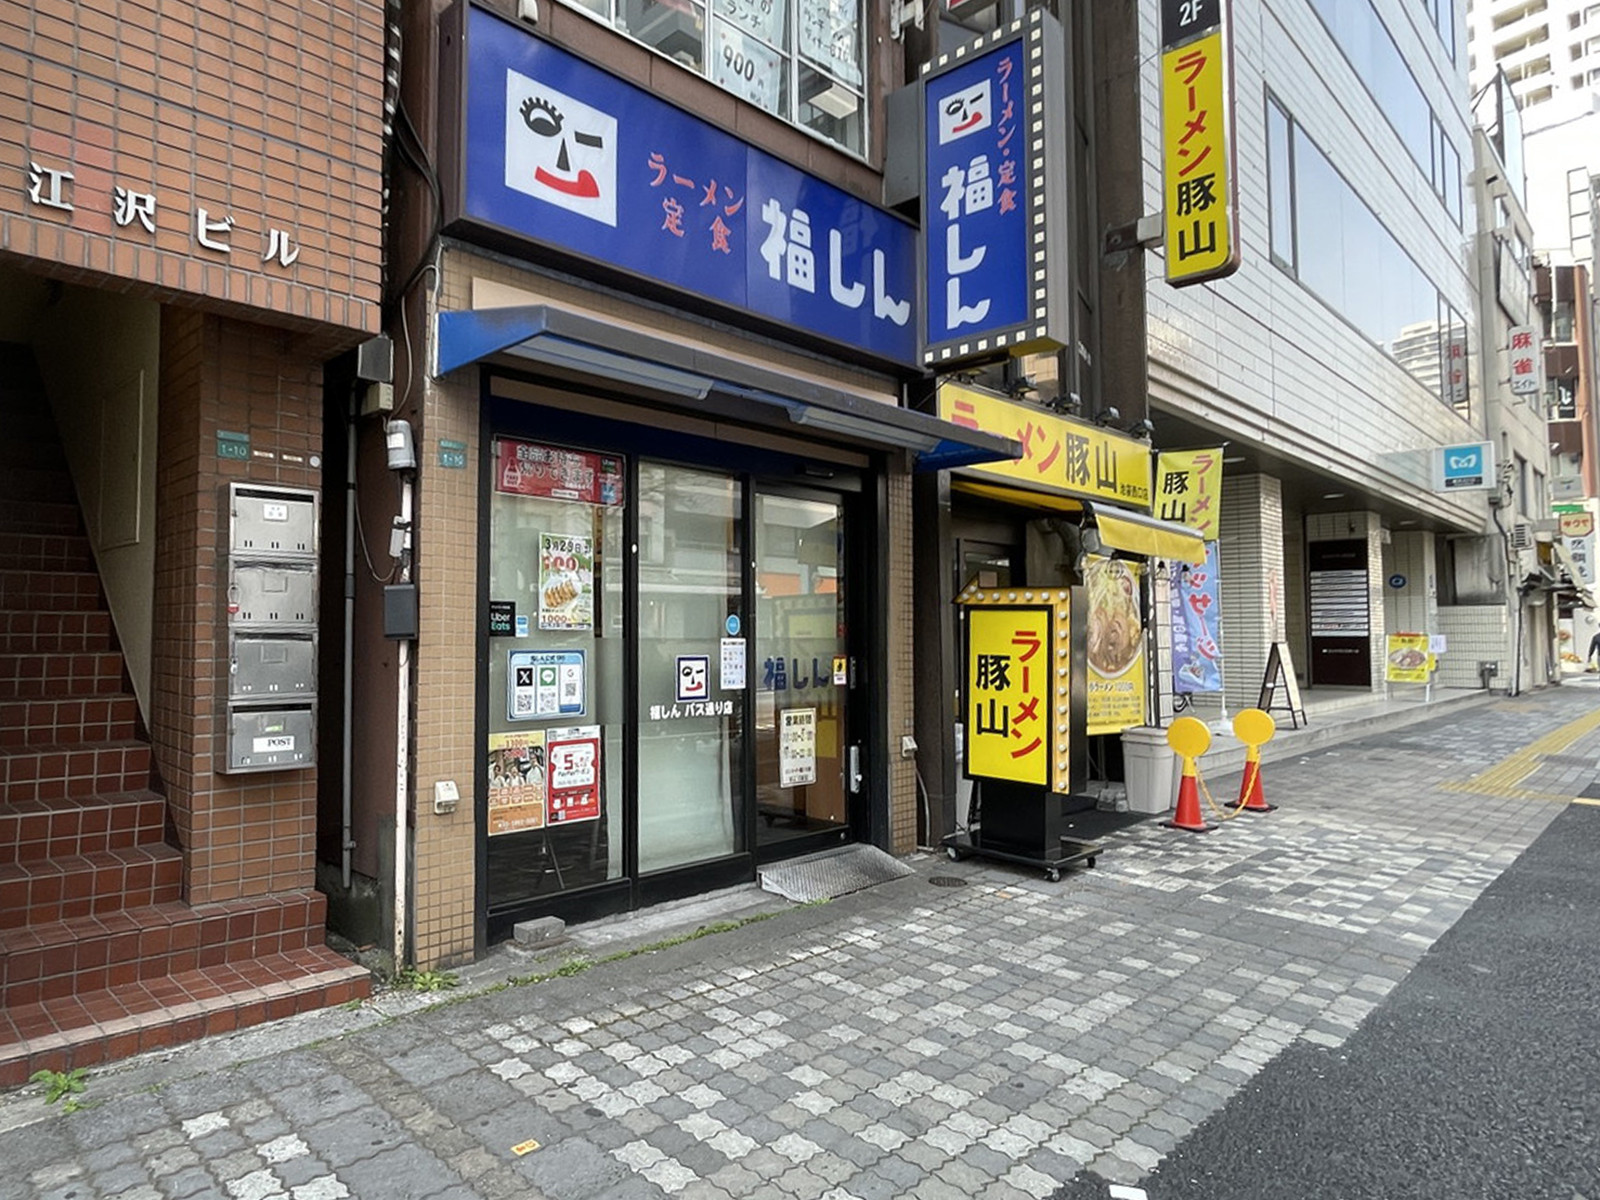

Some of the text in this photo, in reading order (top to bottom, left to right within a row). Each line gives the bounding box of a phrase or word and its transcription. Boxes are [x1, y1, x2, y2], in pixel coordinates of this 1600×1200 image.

[1179, 0, 1203, 26] 2F
[723, 45, 755, 82] 900
[760, 198, 911, 326] 福しん
[939, 154, 994, 330] 福しん
[1160, 470, 1189, 523] 豚山
[491, 613, 511, 622] Uber
[976, 654, 1011, 738] 豚山
[1011, 630, 1042, 758] ラーメン
[267, 738, 291, 747] POST
